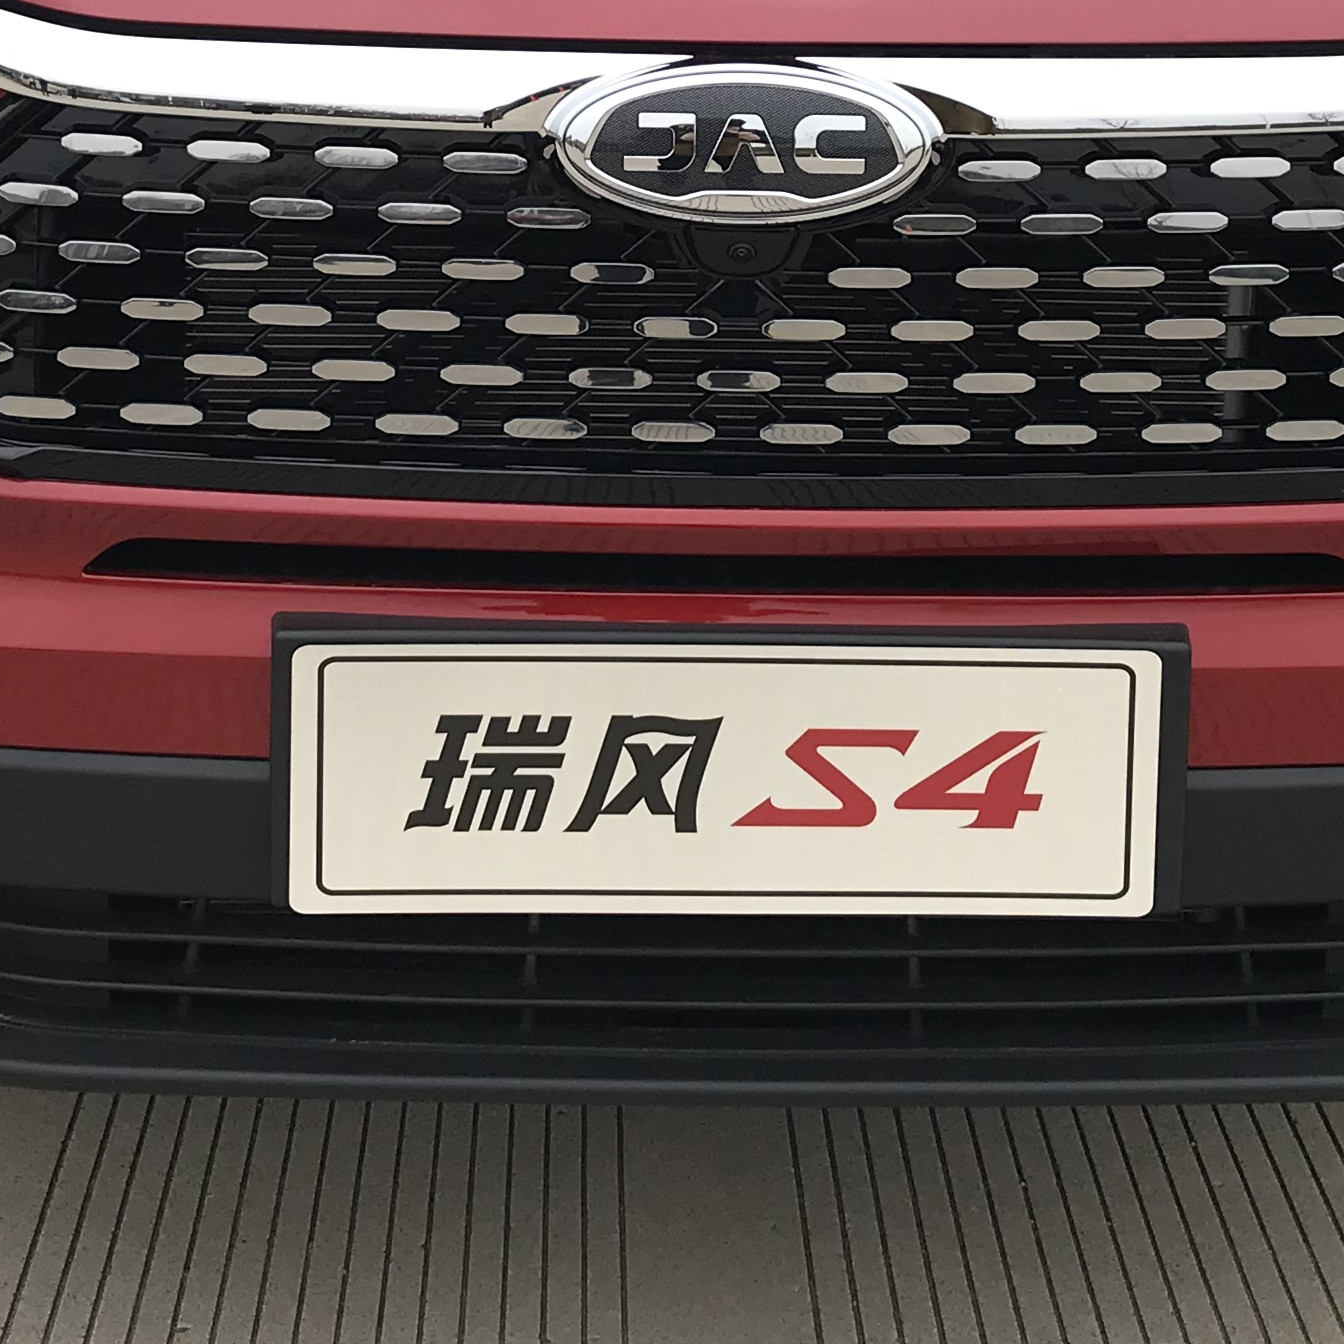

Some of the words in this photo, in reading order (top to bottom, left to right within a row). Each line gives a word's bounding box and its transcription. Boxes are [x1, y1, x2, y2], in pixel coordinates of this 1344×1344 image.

[623, 112, 867, 175] JAC
[403, 714, 725, 834] 瑞风
[730, 728, 1048, 830] S4
